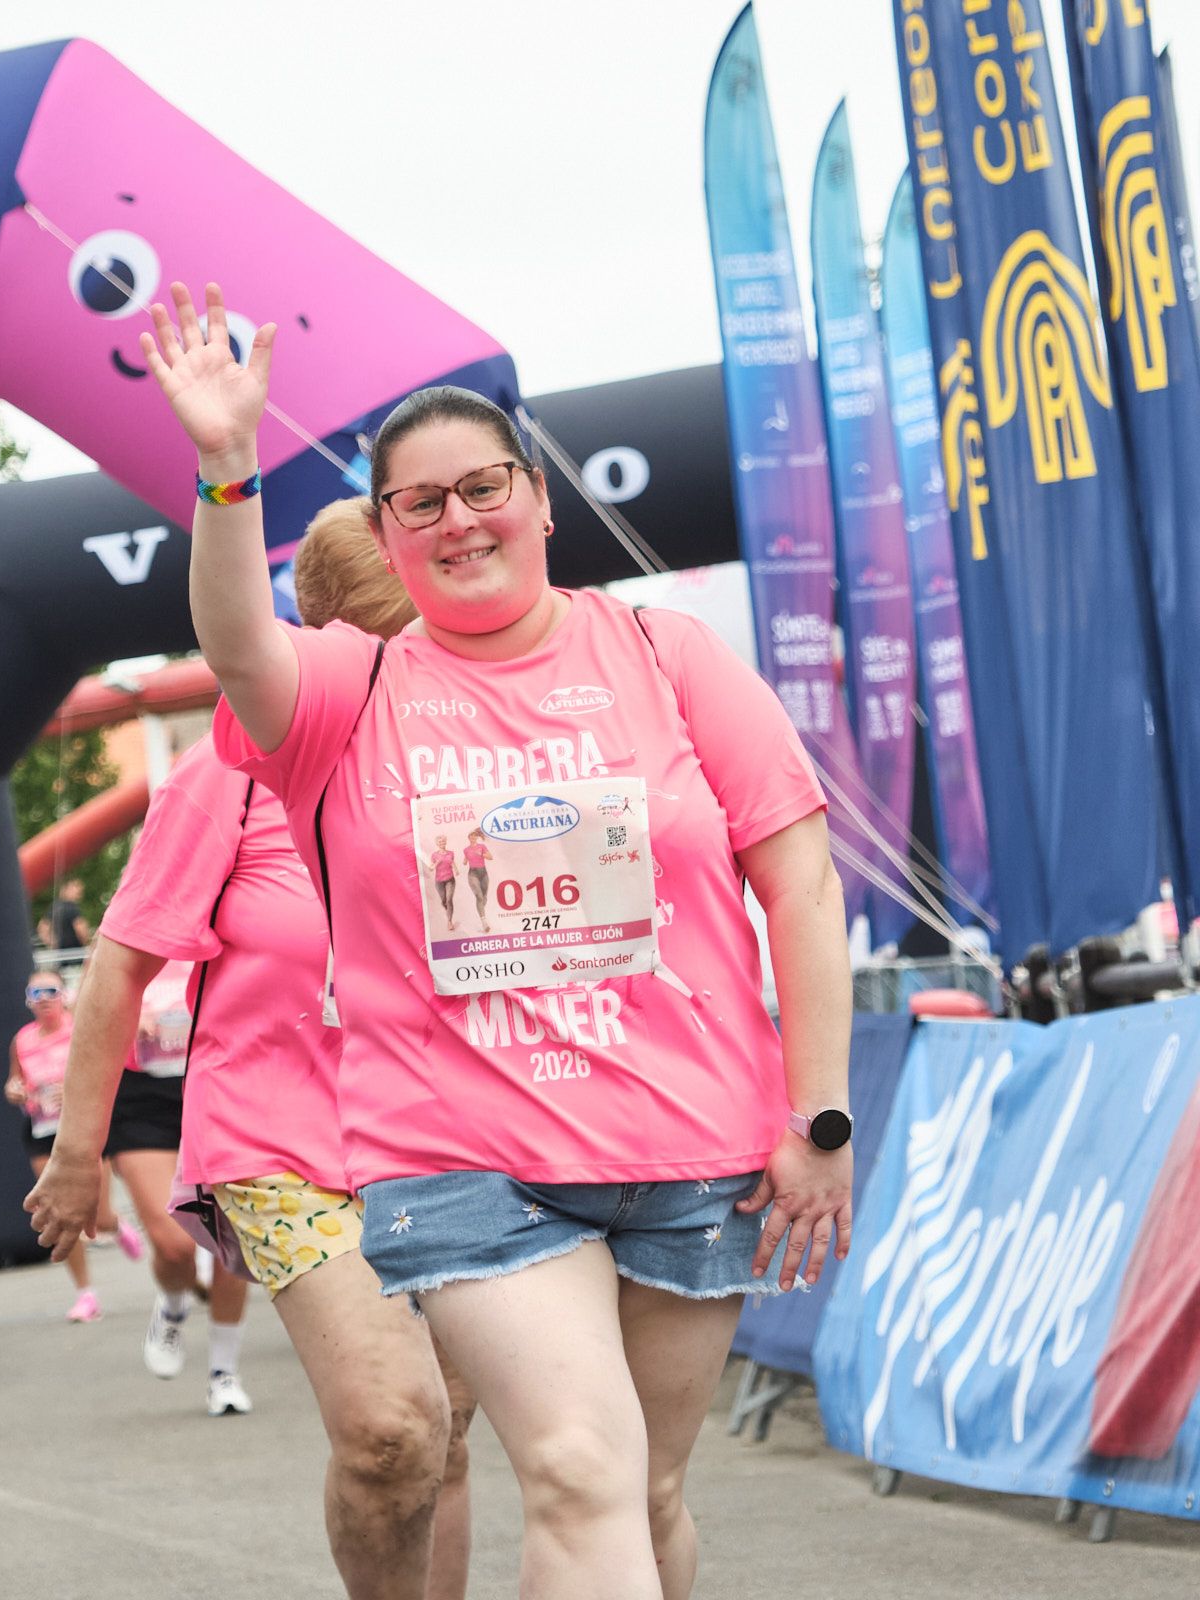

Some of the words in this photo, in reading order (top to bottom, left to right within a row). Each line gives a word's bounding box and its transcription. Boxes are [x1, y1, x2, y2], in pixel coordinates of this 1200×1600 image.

[408, 730, 610, 792] CARRERA
[433, 810, 476, 825] SUMA
[489, 814, 573, 833] ASTURIANA
[496, 874, 580, 911] 016
[522, 915, 561, 932] 2747
[460, 939, 510, 954] CARRERA
[512, 936, 527, 948] DE
[529, 934, 544, 947] LA
[546, 931, 583, 945] MUJER
[592, 926, 624, 941] GIJÓN
[455, 961, 526, 982] OYSHO
[569, 953, 635, 970] Santander
[466, 989, 628, 1048] MUJER
[529, 1049, 592, 1083] 2026
